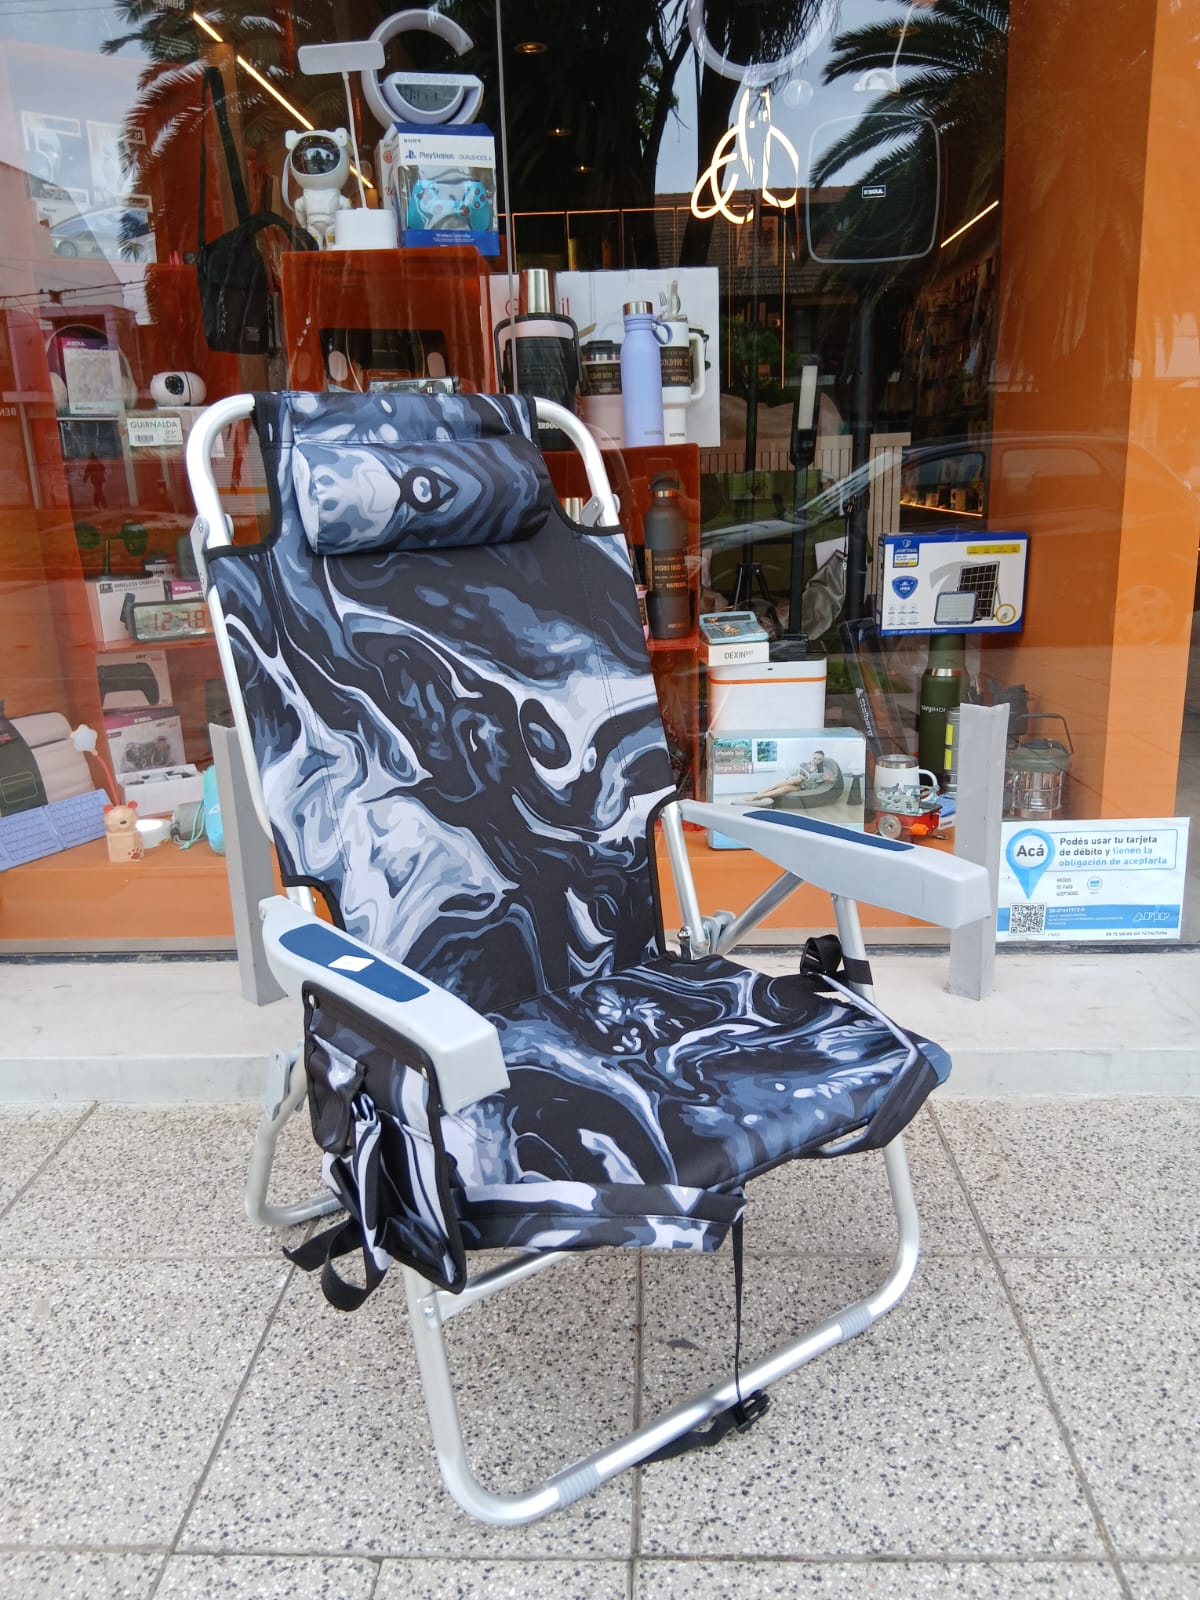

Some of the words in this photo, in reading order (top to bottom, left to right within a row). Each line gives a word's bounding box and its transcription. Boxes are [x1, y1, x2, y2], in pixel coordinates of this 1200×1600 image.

[419, 152, 455, 160] PlayStation
[130, 421, 178, 429] GUIRNALDA
[1059, 836, 1088, 846] Podés
[1091, 837, 1111, 845] usar
[1114, 836, 1123, 844] tu
[1126, 835, 1157, 845] tarjeta
[1016, 844, 1045, 857] Acá
[1059, 848, 1071, 857] de
[1074, 847, 1102, 856] débito
[1105, 849, 1110, 857] y
[1112, 846, 1141, 855] tienen
[1143, 846, 1153, 854] la
[1058, 856, 1107, 868] obligación
[1109, 856, 1120, 866] de
[1123, 856, 1167, 866] aceptarla
